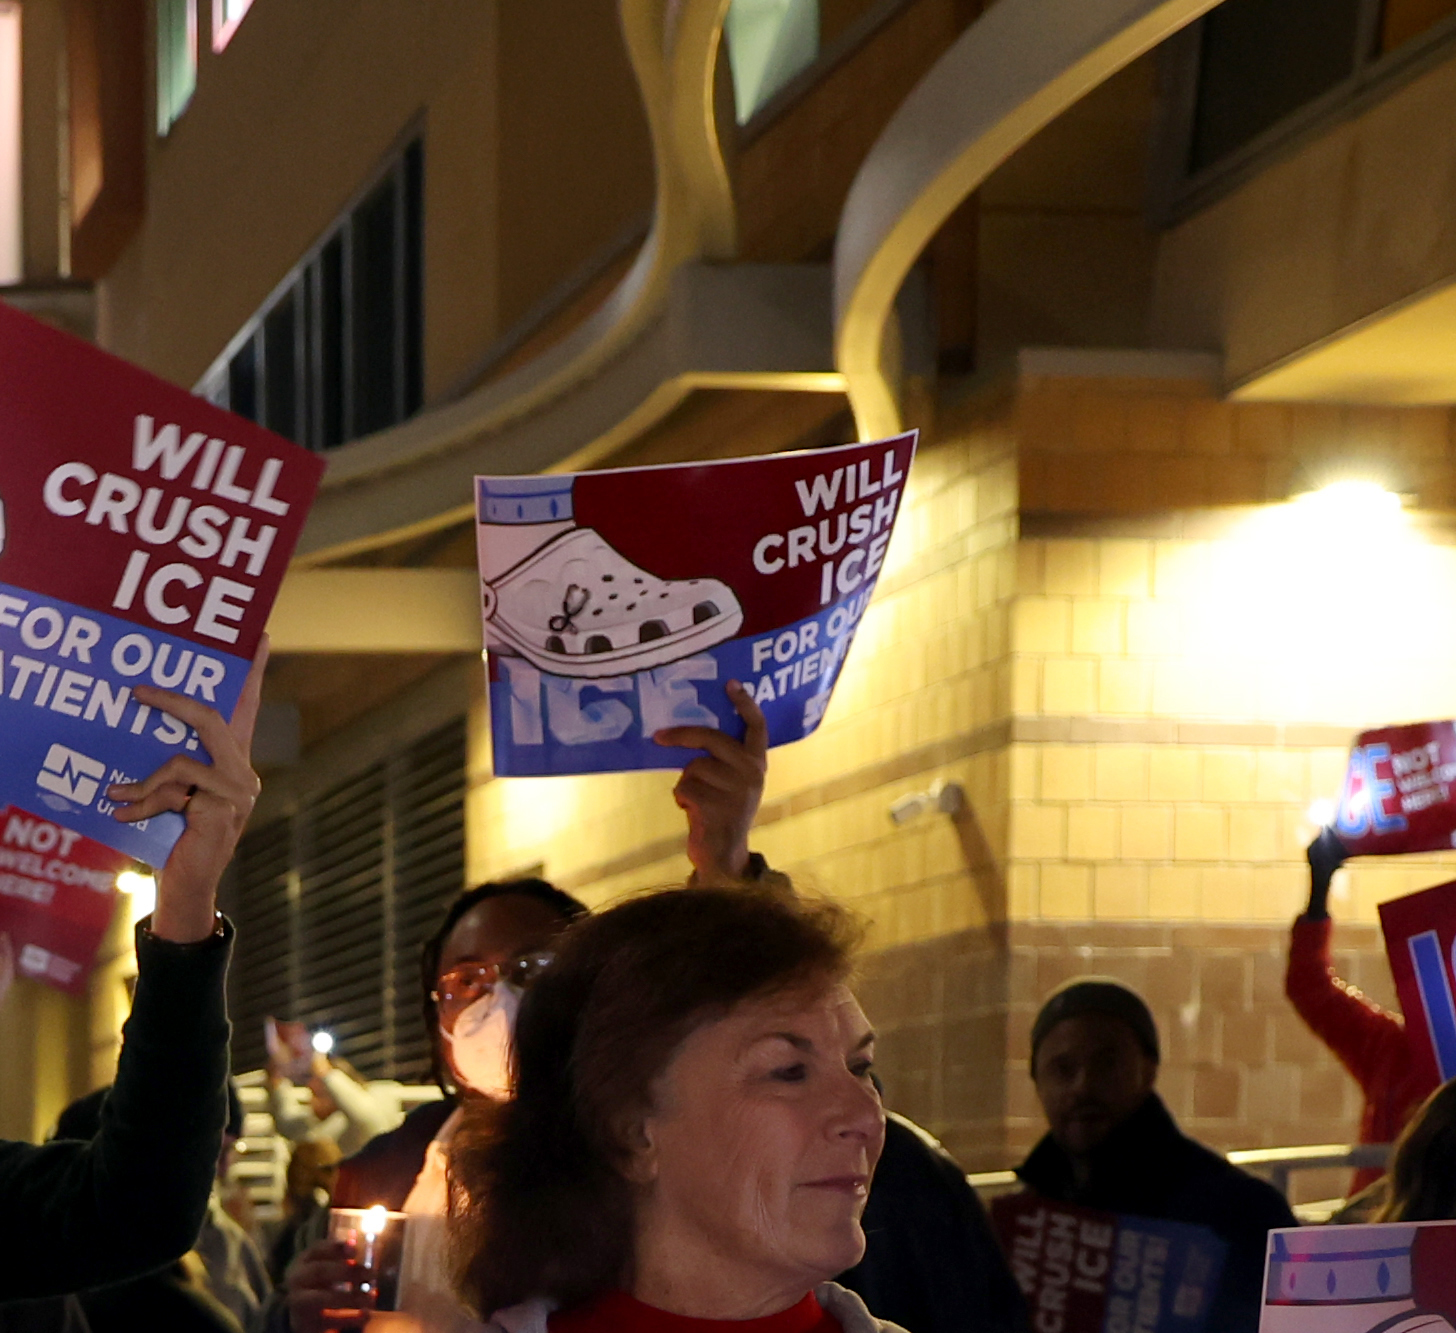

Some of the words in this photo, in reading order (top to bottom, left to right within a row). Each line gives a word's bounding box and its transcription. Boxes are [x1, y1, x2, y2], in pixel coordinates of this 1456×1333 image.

[130, 413, 290, 517] WILL
[794, 449, 904, 518] WILL
[42, 461, 278, 577] CRUSH
[752, 489, 898, 575] CRUSH
[112, 550, 256, 644] ICE
[819, 530, 889, 605] ICE
[110, 629, 227, 702] OUR
[752, 619, 817, 673] FOR
[2, 816, 83, 857] NOT
[1073, 1220, 1114, 1294] ICE
